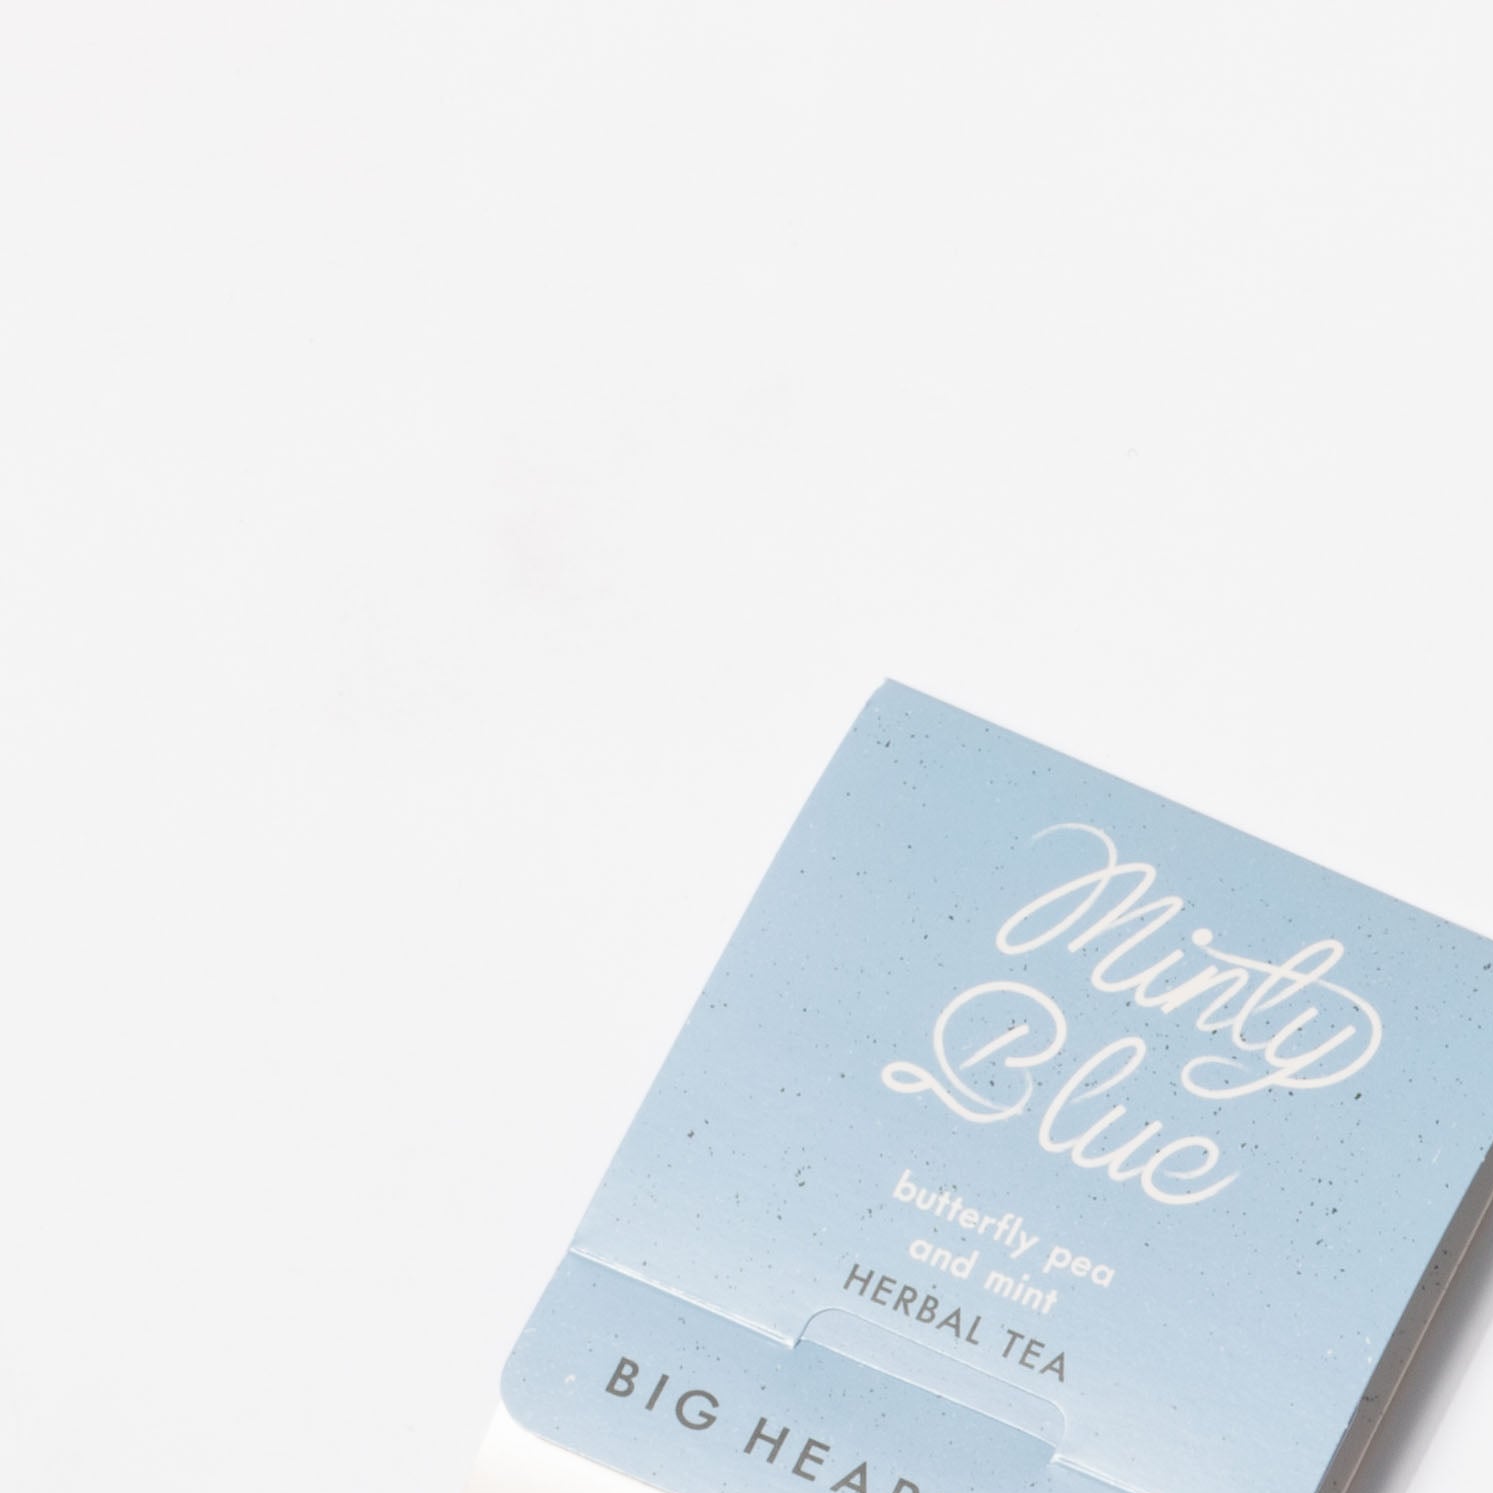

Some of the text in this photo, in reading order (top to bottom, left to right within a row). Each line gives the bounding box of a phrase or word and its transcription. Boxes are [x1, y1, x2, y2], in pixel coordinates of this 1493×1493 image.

[995, 822, 1383, 1100] Minty
[881, 980, 1240, 1205] Blue
[892, 1168, 1116, 1289] butterfly pea
[908, 1239, 1058, 1315] and mint
[842, 1262, 1065, 1383] HERBAL TEA
[604, 1355, 720, 1432] BIG
